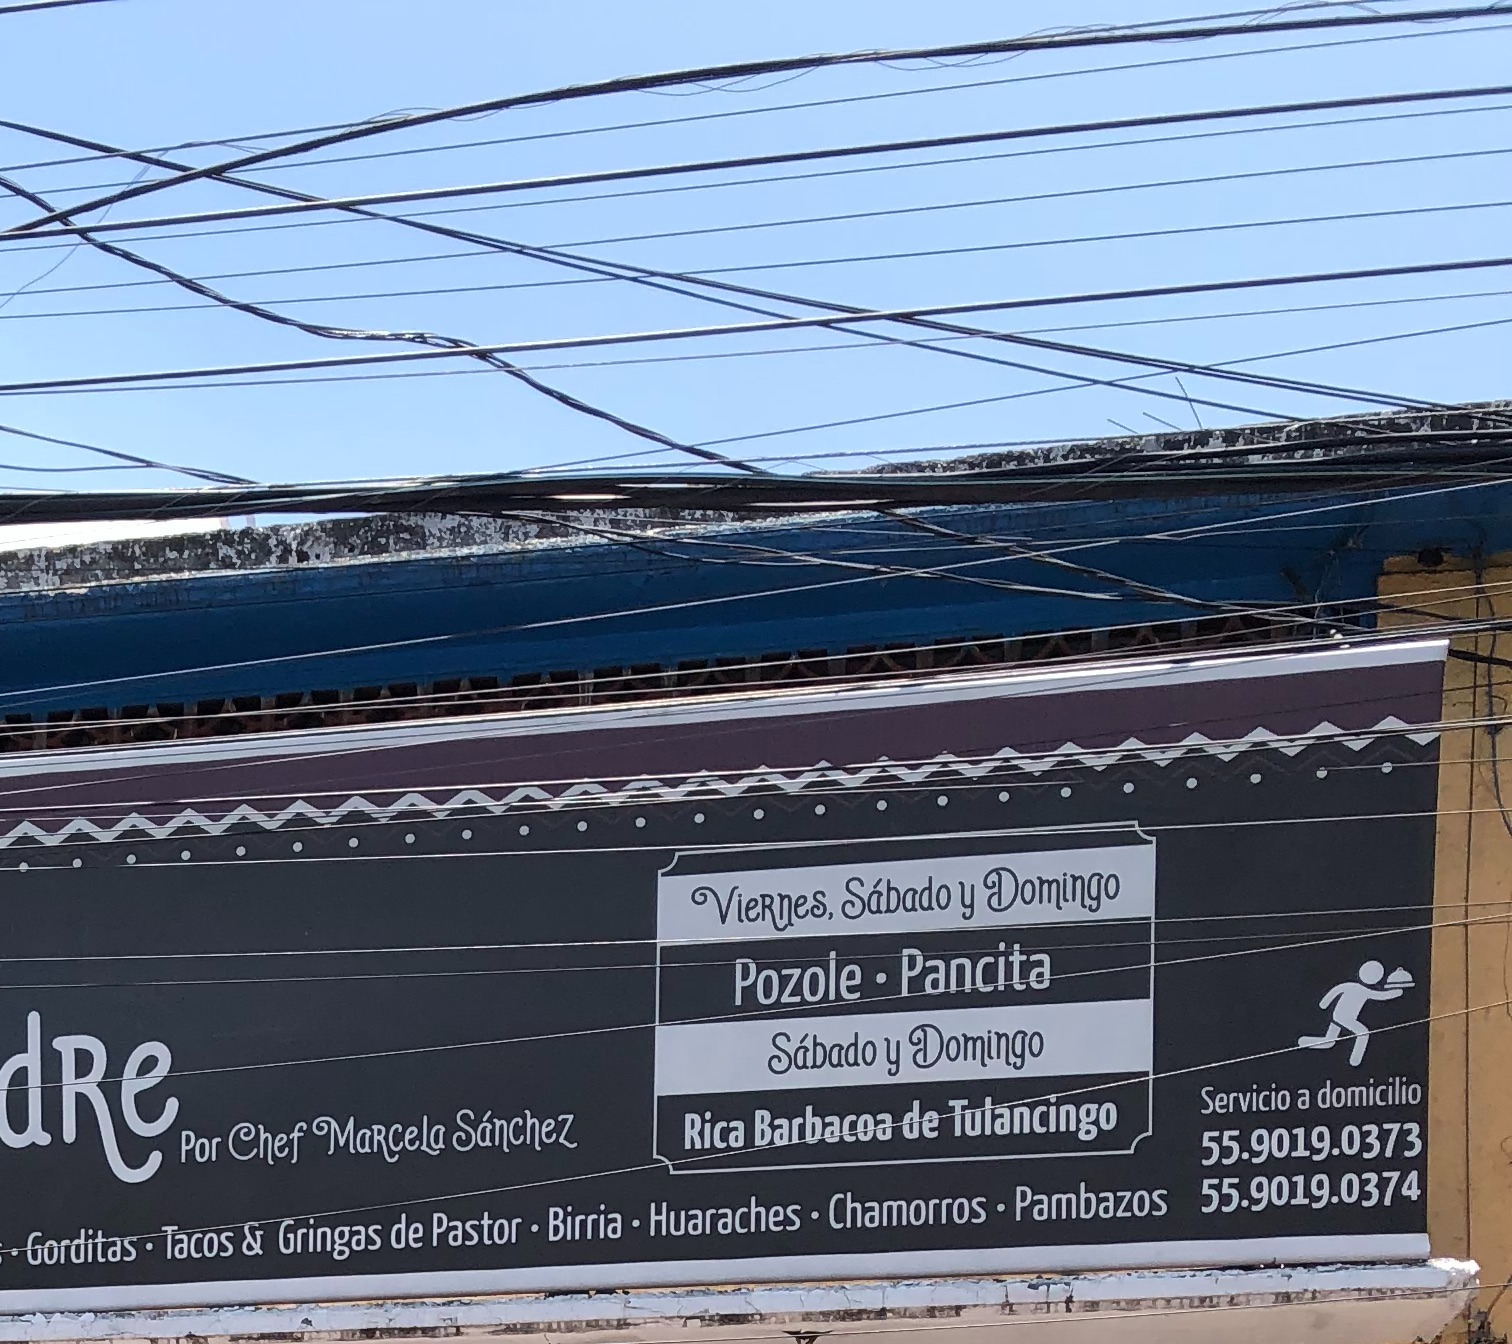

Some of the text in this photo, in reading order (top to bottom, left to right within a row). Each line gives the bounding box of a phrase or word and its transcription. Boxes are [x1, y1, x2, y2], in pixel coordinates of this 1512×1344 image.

[841, 876, 952, 920] Sábado
[960, 880, 976, 921] y
[983, 866, 1122, 913] Domingo
[734, 942, 1052, 1006] Pozole Pancita
[767, 1023, 1045, 1077] Sábado y Domingo
[683, 1095, 1118, 1150] Rica Barbacoa de Tulancingo
[1200, 1076, 1422, 1115] Servicio a domicilio
[181, 1131, 221, 1163] Por
[228, 1121, 306, 1166] Chef
[452, 1109, 578, 1152] Sánchez
[1201, 1122, 1423, 1166] 55.9019.0373
[1200, 1169, 1421, 1214] 55.9019.0374
[26, 1229, 137, 1266] Gorditas
[162, 1225, 234, 1261] Tacos
[242, 1222, 264, 1256] &
[278, 1218, 382, 1261] Gringas
[390, 1213, 423, 1249] de
[432, 1211, 523, 1247] Pastor
[548, 1204, 622, 1243] Birria
[649, 1196, 801, 1237] Huaraches
[828, 1193, 987, 1229] Chamorros
[1015, 1182, 1168, 1222] Pambazos
